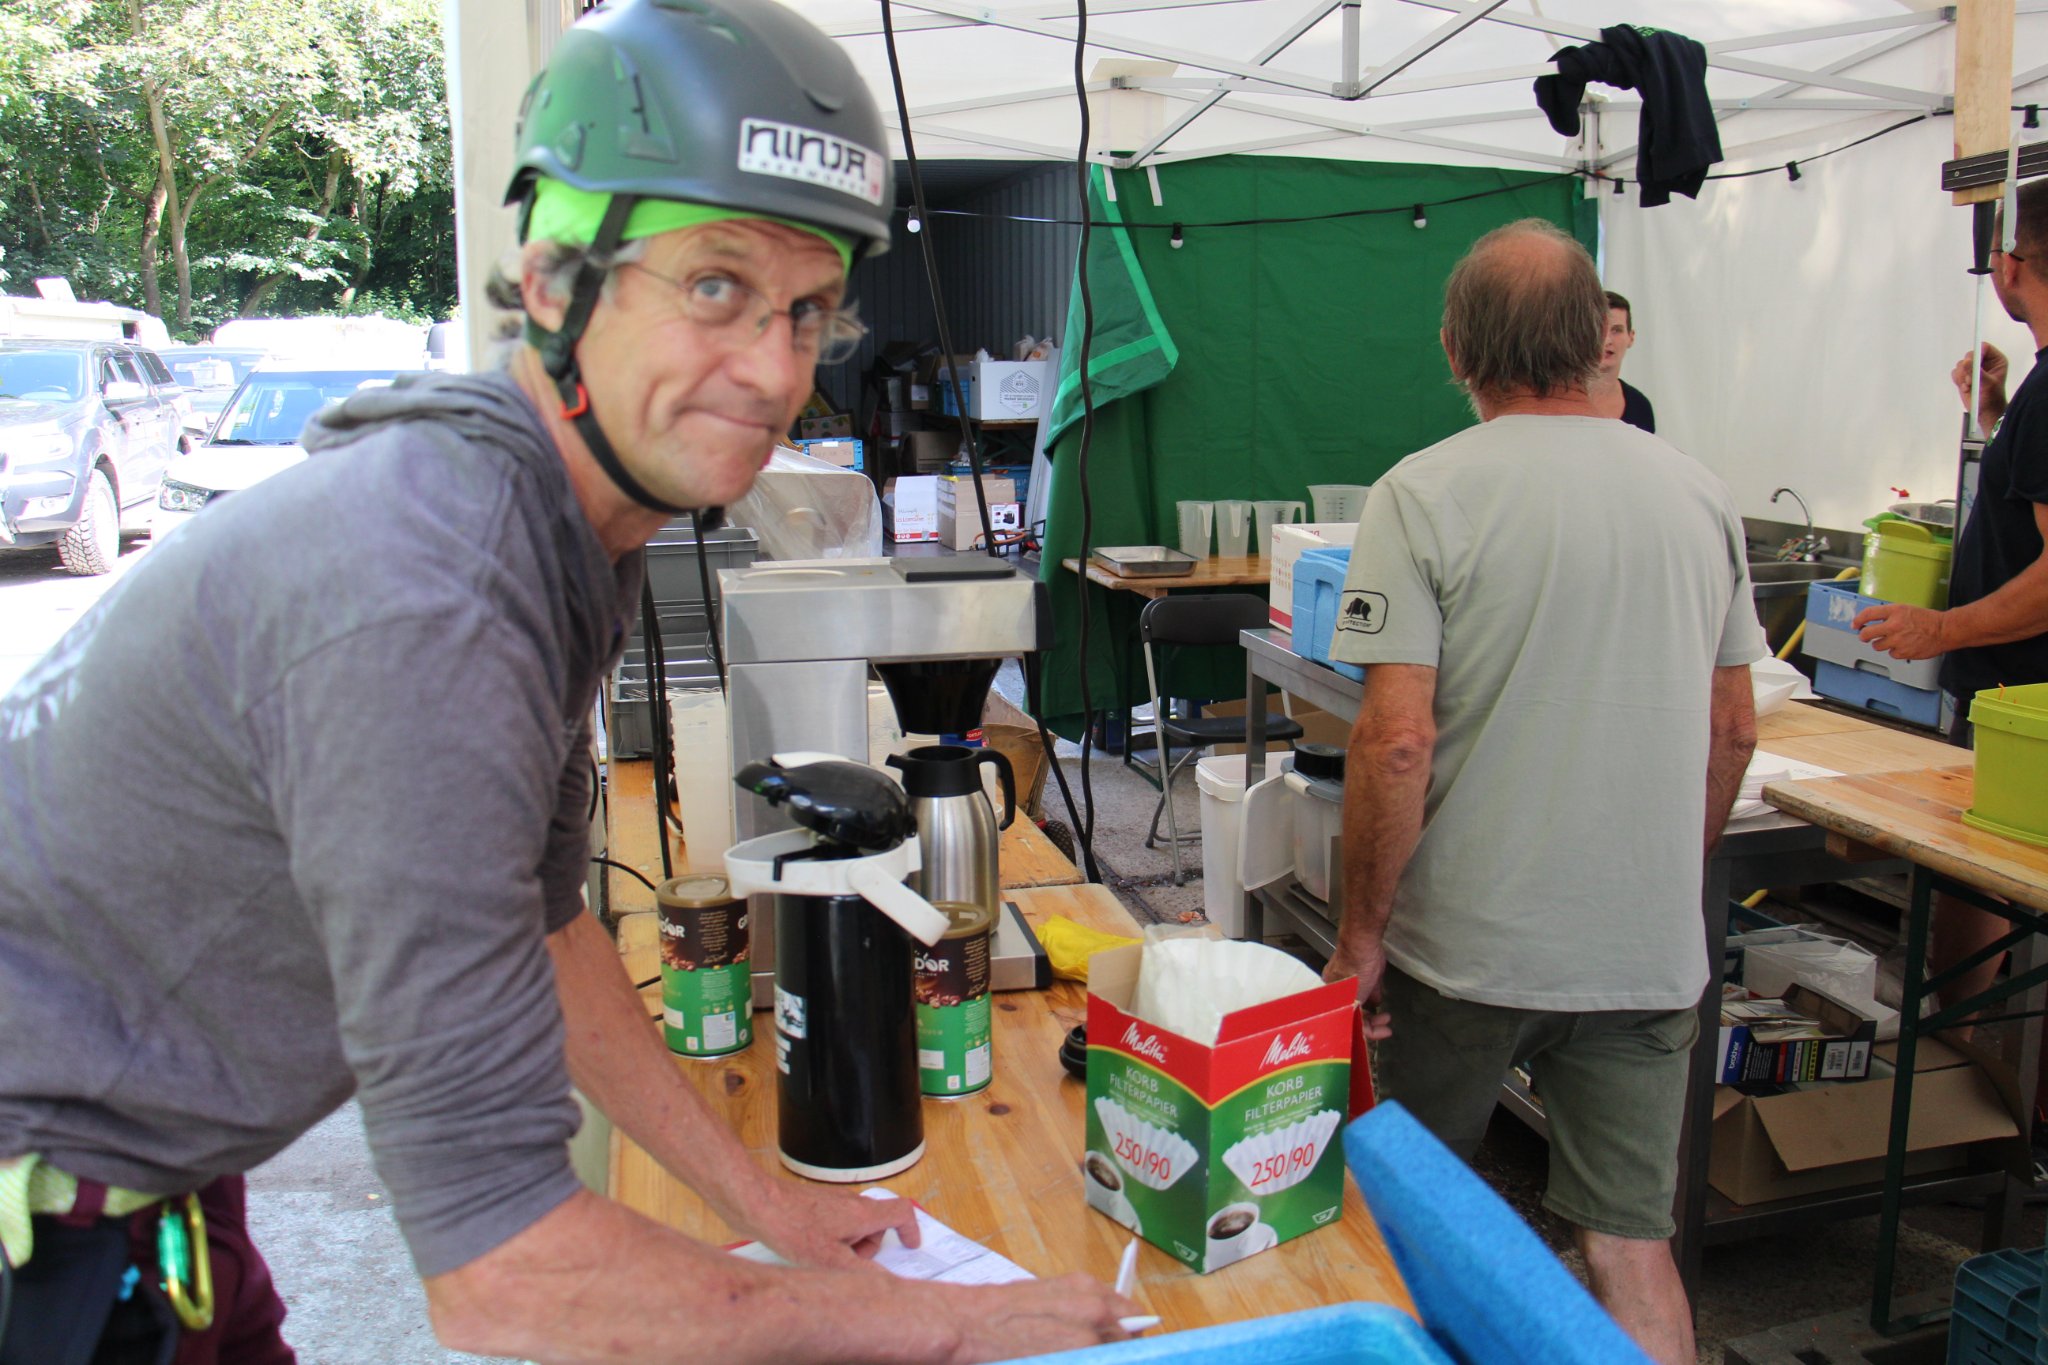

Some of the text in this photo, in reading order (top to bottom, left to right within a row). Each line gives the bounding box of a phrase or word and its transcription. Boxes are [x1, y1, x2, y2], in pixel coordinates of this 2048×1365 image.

[1120, 1021, 1166, 1063] Melitta
[1258, 1031, 1312, 1071] Melitta
[1727, 1041, 1740, 1068] brother
[1109, 1073, 1178, 1118] FILTERPAPIER
[1125, 1065, 1159, 1093] KORB
[1266, 1075, 1304, 1099] KORB
[1244, 1086, 1323, 1122] FILTERPAPIER
[1114, 1132, 1171, 1181] 250/90
[1250, 1142, 1315, 1187] 250/90
